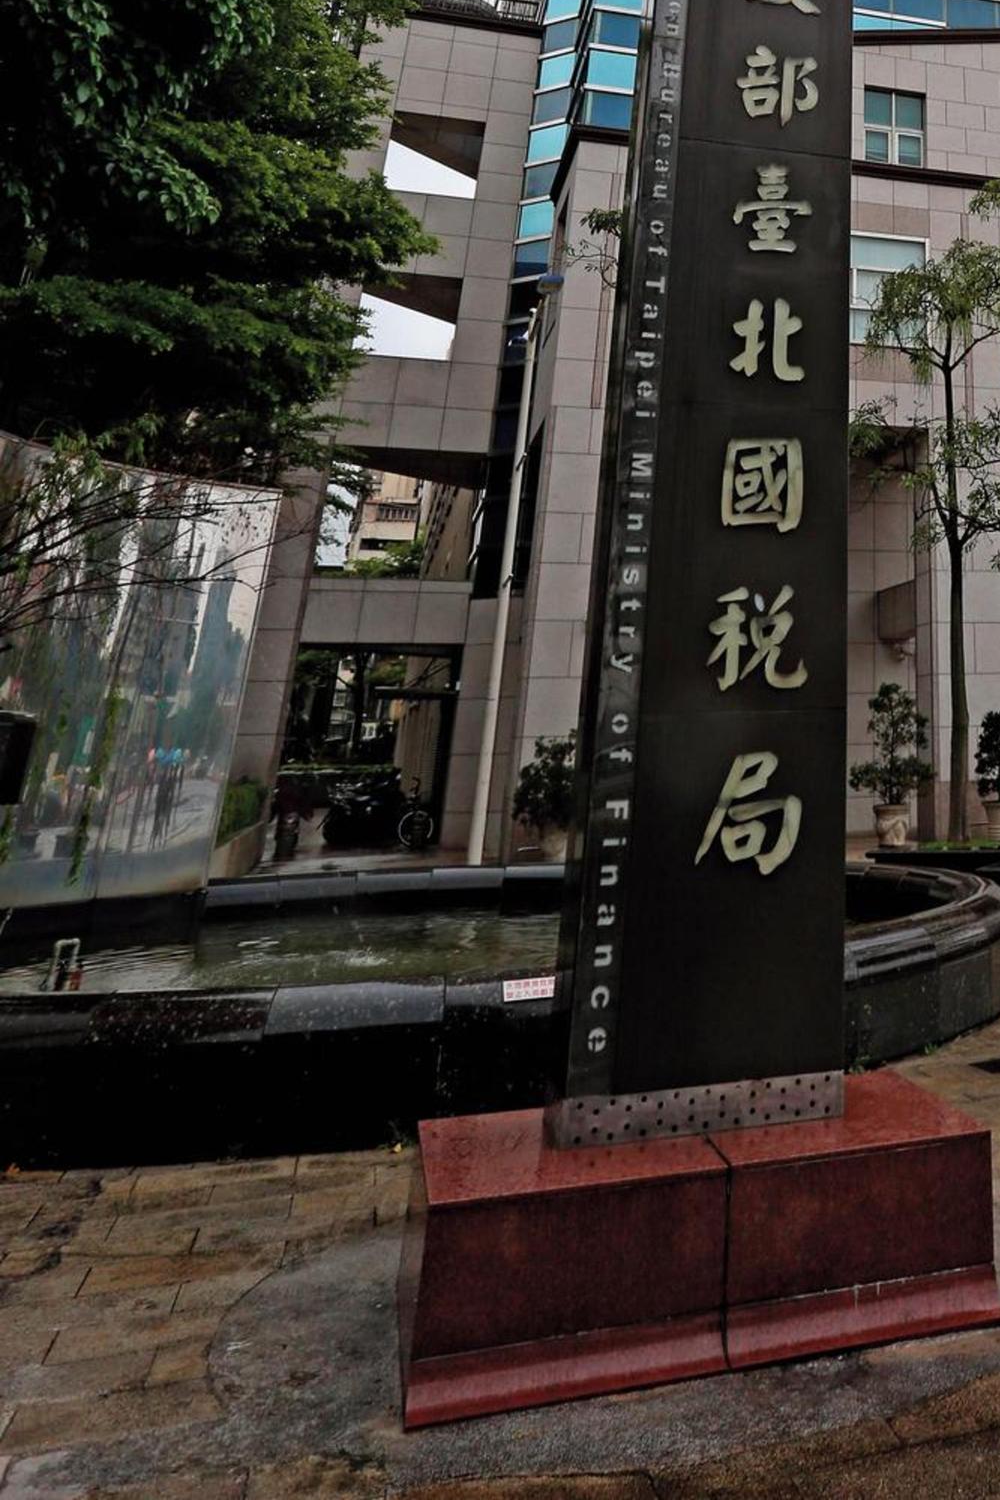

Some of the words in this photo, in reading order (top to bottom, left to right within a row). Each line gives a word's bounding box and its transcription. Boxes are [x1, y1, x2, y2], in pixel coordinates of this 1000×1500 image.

[652, 60, 681, 199] Bureau
[646, 219, 669, 258] of
[633, 275, 667, 418] Taipei
[610, 452, 655, 674] Ministry
[608, 713, 633, 763] of
[587, 799, 630, 1053] Finance
